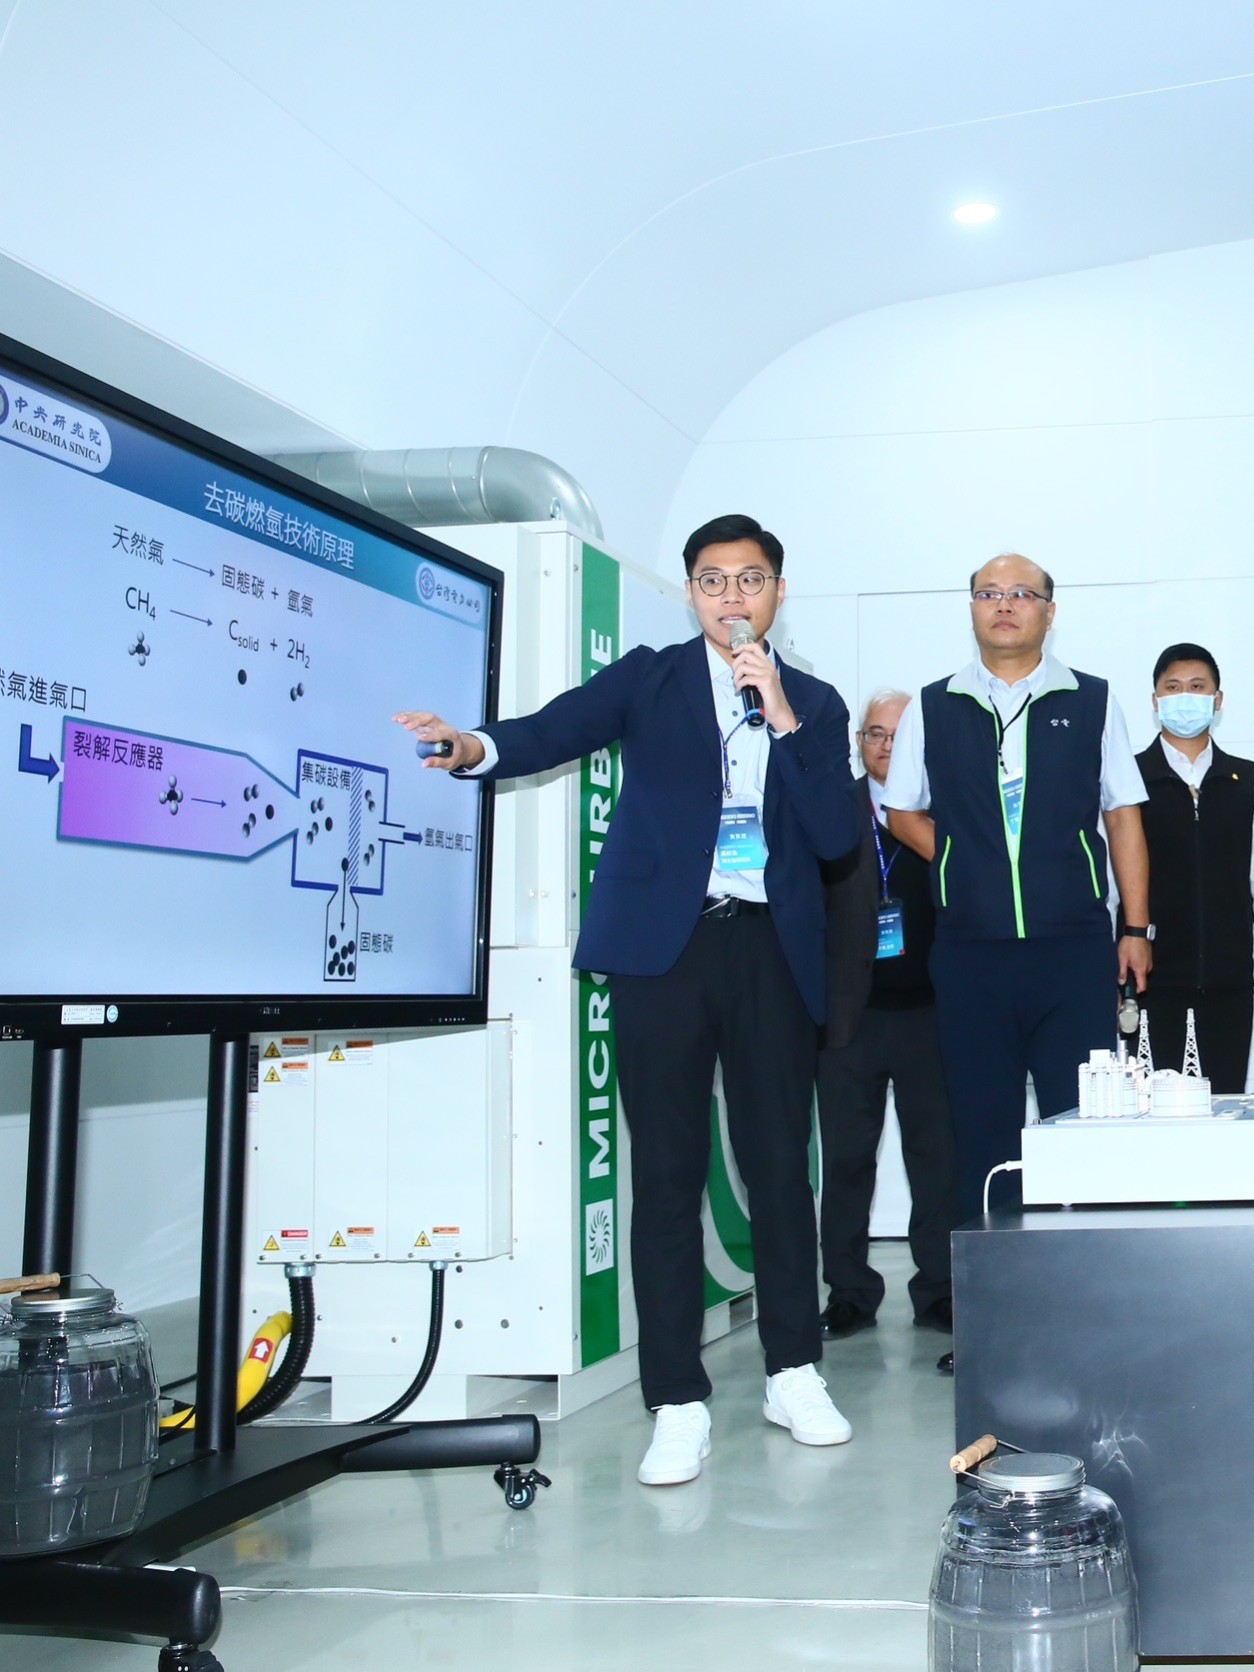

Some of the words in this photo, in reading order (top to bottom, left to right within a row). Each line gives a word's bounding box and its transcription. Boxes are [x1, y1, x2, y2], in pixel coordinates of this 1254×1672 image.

[12, 419, 67, 450] ACADEMIA
[69, 442, 102, 463] SINICA
[14, 396, 102, 447] 中央研究院
[203, 481, 355, 570] 去碳燃氫技術原理
[112, 524, 165, 566] 天然氣
[221, 564, 265, 600] 固態碳
[73, 730, 163, 771] 裂解反應器
[301, 761, 351, 791] 集碳設備
